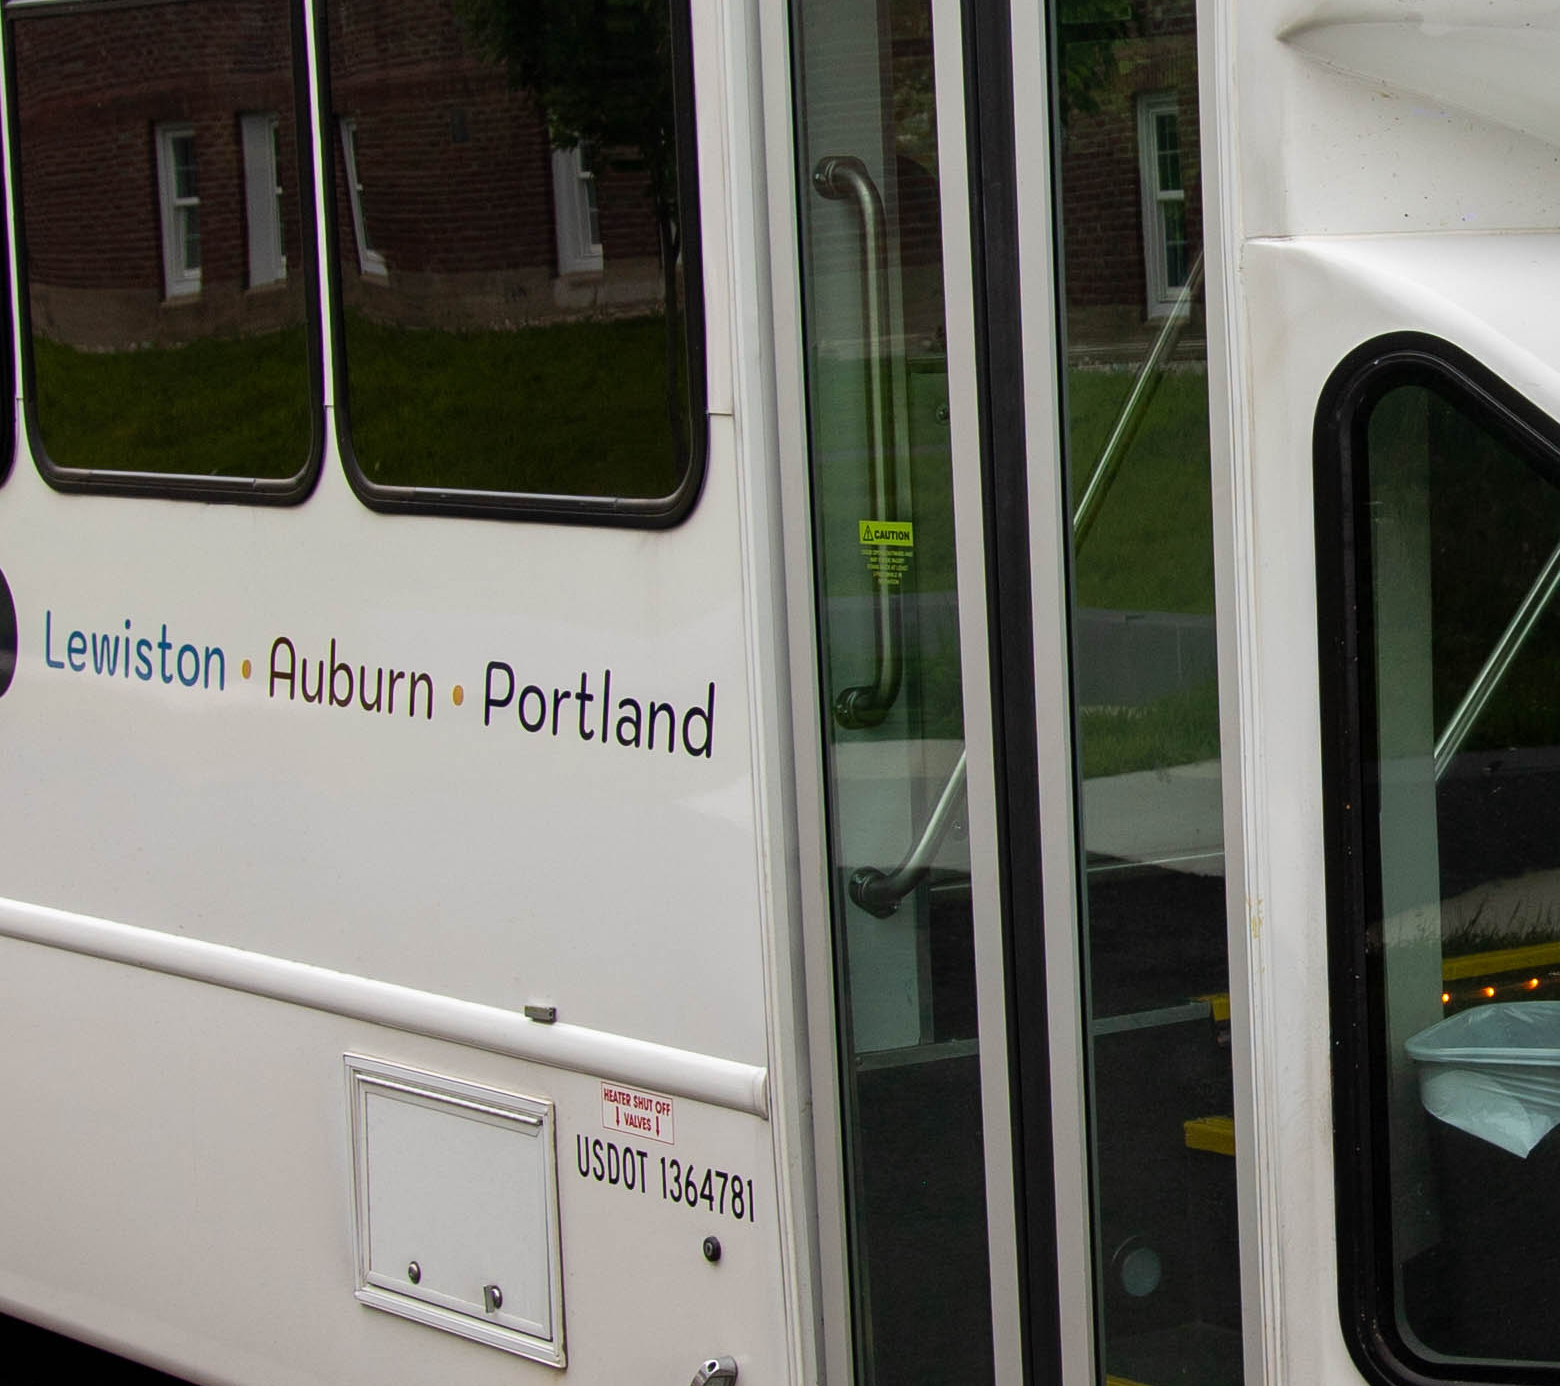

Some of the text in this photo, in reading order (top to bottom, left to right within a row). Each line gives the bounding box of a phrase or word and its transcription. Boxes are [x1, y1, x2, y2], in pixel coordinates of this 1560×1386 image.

[874, 530, 910, 541] CAUTION
[44, 610, 715, 758] Lewiston Auburn Portland
[604, 1088, 671, 1117] HEATER SHUT OFF
[624, 1112, 651, 1132] VALVES
[576, 1134, 755, 1223] USDOT 1364781
